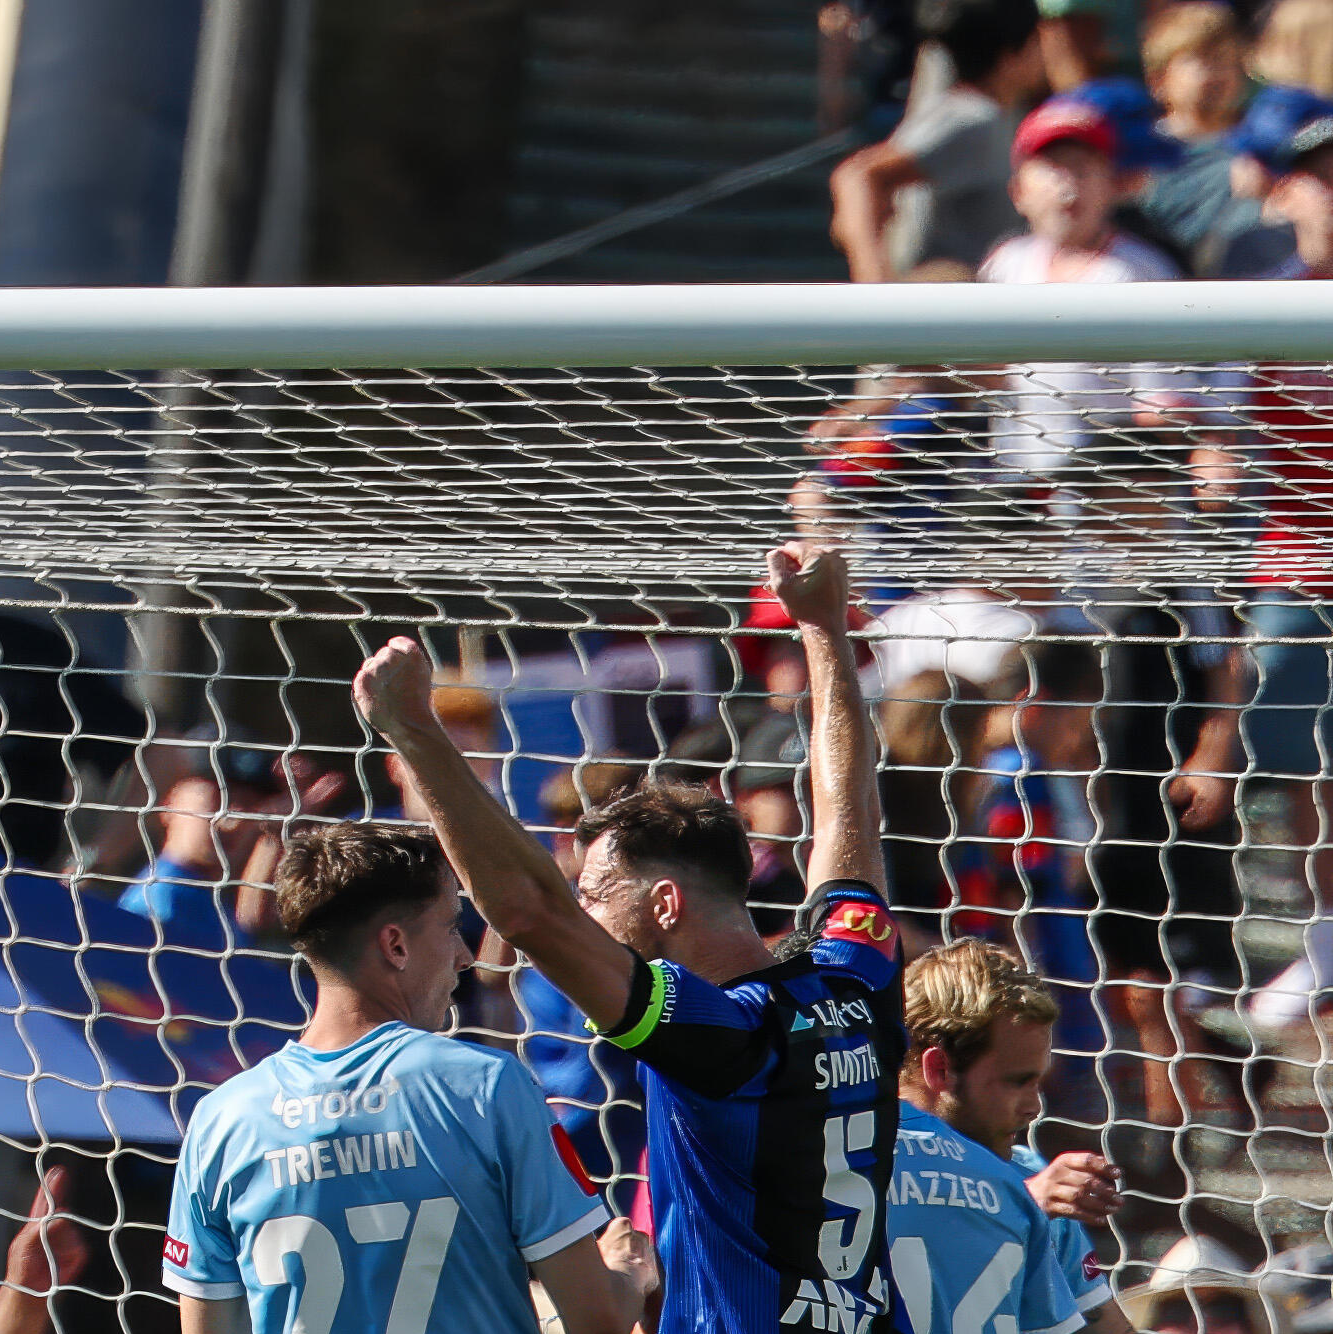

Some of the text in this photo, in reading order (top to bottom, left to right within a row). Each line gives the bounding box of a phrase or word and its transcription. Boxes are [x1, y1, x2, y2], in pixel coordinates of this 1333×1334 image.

[815, 1043, 880, 1090] SMITH
[264, 1130, 417, 1189] TREWIN
[818, 1110, 878, 1280] 5
